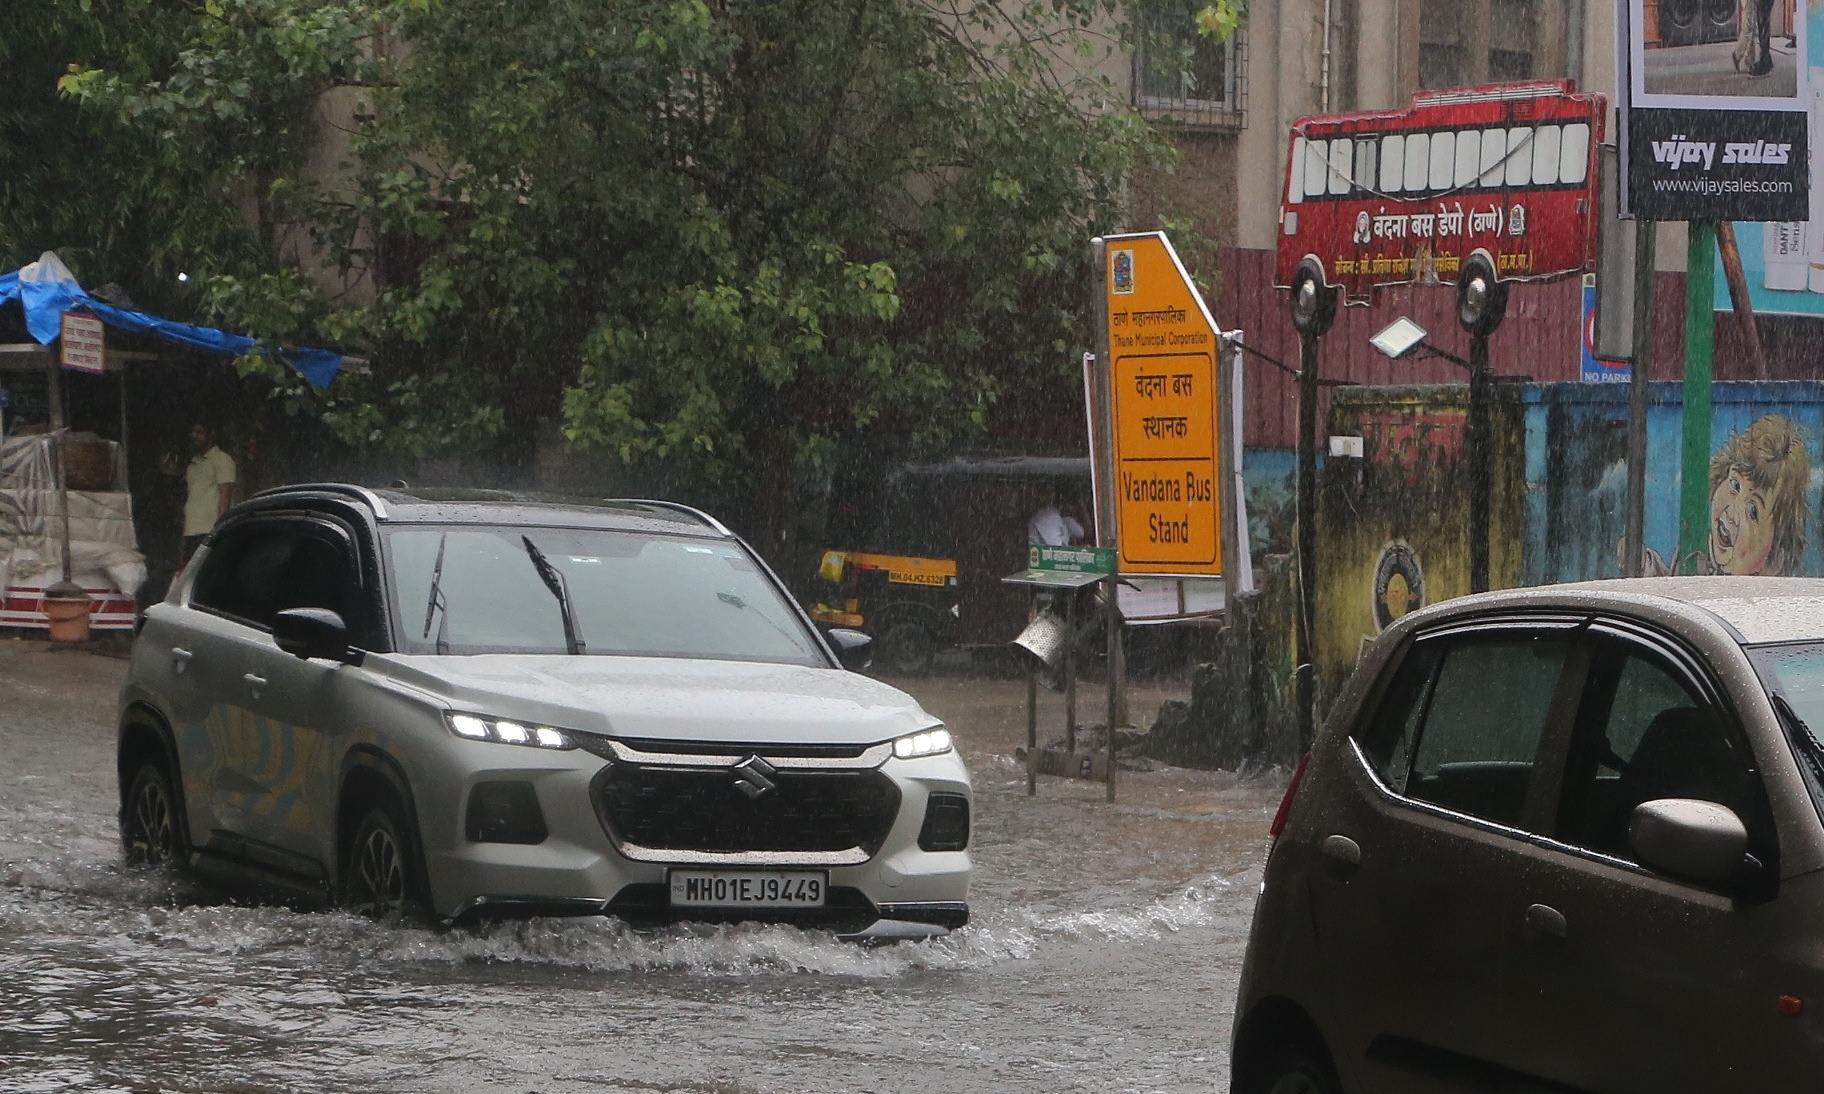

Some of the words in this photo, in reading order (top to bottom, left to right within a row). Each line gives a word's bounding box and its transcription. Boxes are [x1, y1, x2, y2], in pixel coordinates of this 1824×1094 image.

[1652, 135, 1716, 171] vijay
[1722, 140, 1792, 165] sales
[1653, 177, 1793, 196] www.vijaysales.com
[1373, 206, 1408, 240] वंदना
[1411, 211, 1435, 237] बस
[1438, 202, 1464, 237] डेपो
[1468, 204, 1504, 238] (ठाणे)
[1780, 224, 1789, 255] DANT
[1113, 309, 1128, 327] ठाणे
[1132, 305, 1186, 327] महानगरपालिका
[1114, 334, 1133, 347] Thane
[1135, 333, 1167, 347] Municipal
[1169, 331, 1208, 346] Corporation
[1135, 367, 1167, 400] वंदना
[1172, 374, 1193, 397] बस
[1585, 372, 1599, 382] NO
[1601, 373, 1631, 383] PARKI
[1143, 416, 1188, 440] स्थानक
[1123, 471, 1181, 502] Vandana
[1186, 471, 1211, 502] Bus
[1149, 512, 1189, 543] Stand
[686, 878, 821, 902] MH01EJ9449
